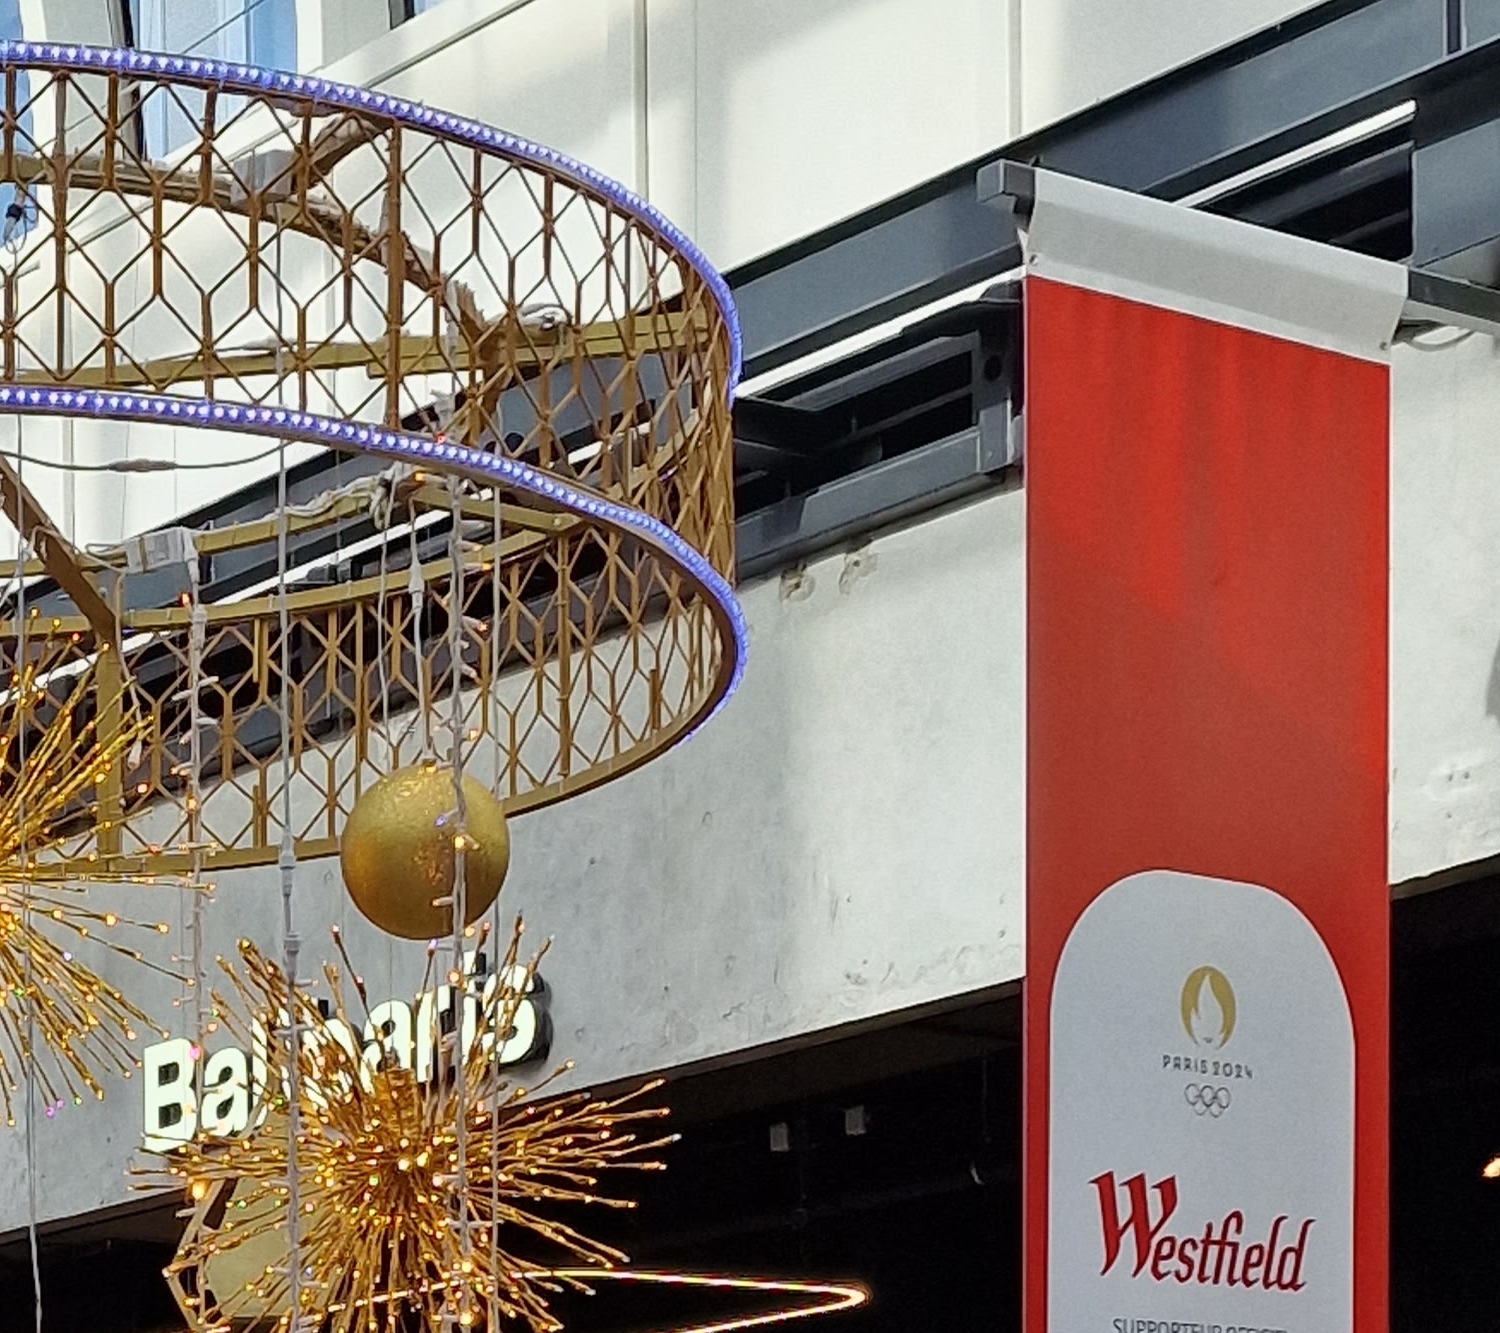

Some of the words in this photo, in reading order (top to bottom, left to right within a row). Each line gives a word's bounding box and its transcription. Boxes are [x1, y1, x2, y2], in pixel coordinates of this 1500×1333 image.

[1161, 1053, 1209, 1075] PARIS
[1211, 1060, 1254, 1080] 2024
[1086, 1169, 1317, 1292] Westfield
